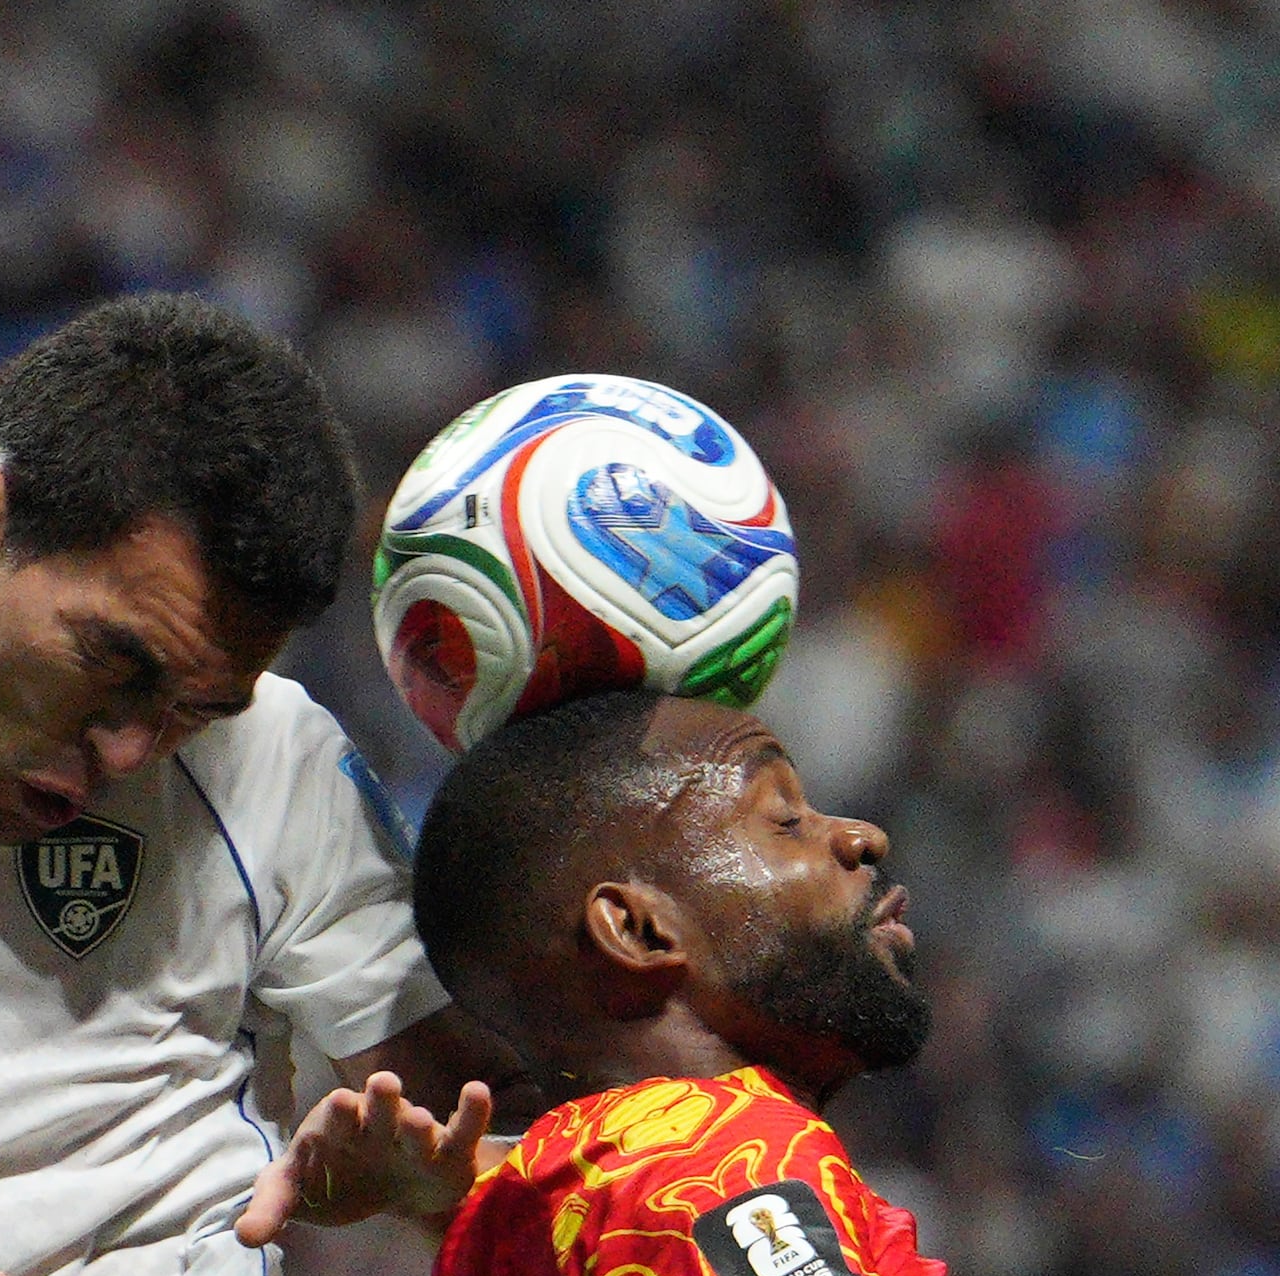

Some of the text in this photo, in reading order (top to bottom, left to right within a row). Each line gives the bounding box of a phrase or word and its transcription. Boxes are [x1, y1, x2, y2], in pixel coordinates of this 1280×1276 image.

[38, 844, 123, 889] UFA
[772, 1249, 799, 1269] FIFA
[803, 1258, 826, 1276] CUP
